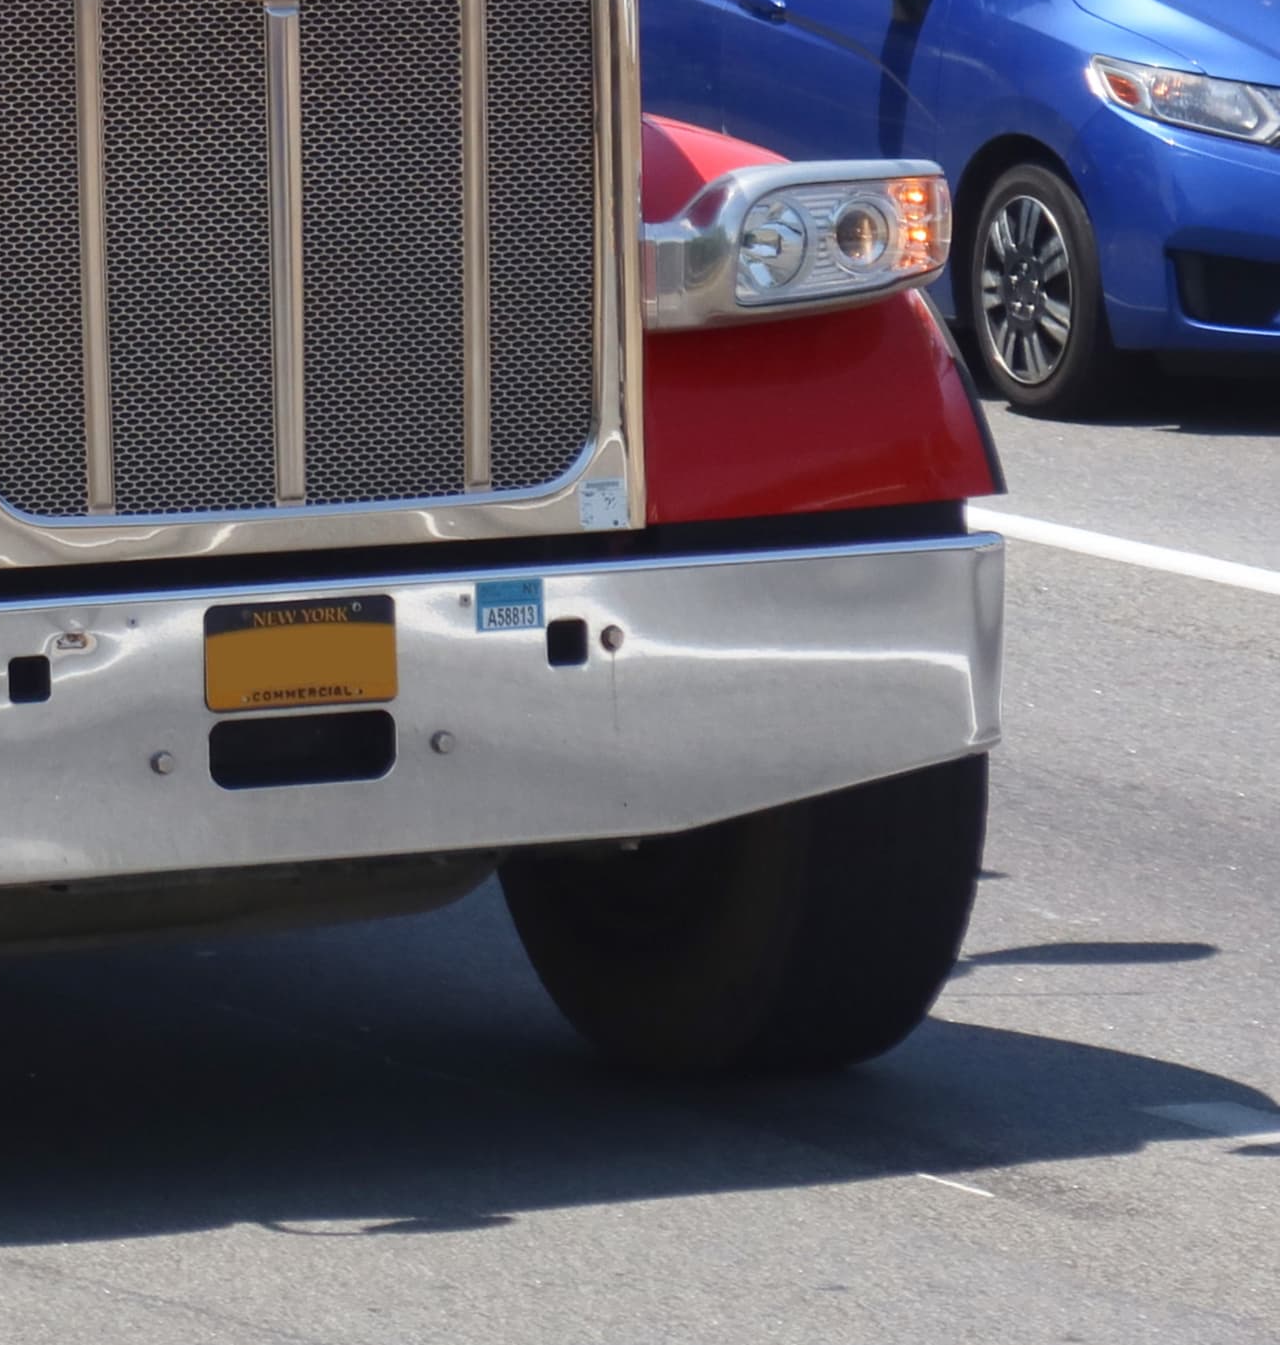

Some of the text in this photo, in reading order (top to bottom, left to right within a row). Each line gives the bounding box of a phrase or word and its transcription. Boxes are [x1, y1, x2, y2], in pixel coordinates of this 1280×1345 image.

[252, 606, 348, 628] NEW YORK
[487, 606, 536, 629] A58813
[251, 684, 353, 703] COMMERCIAL
